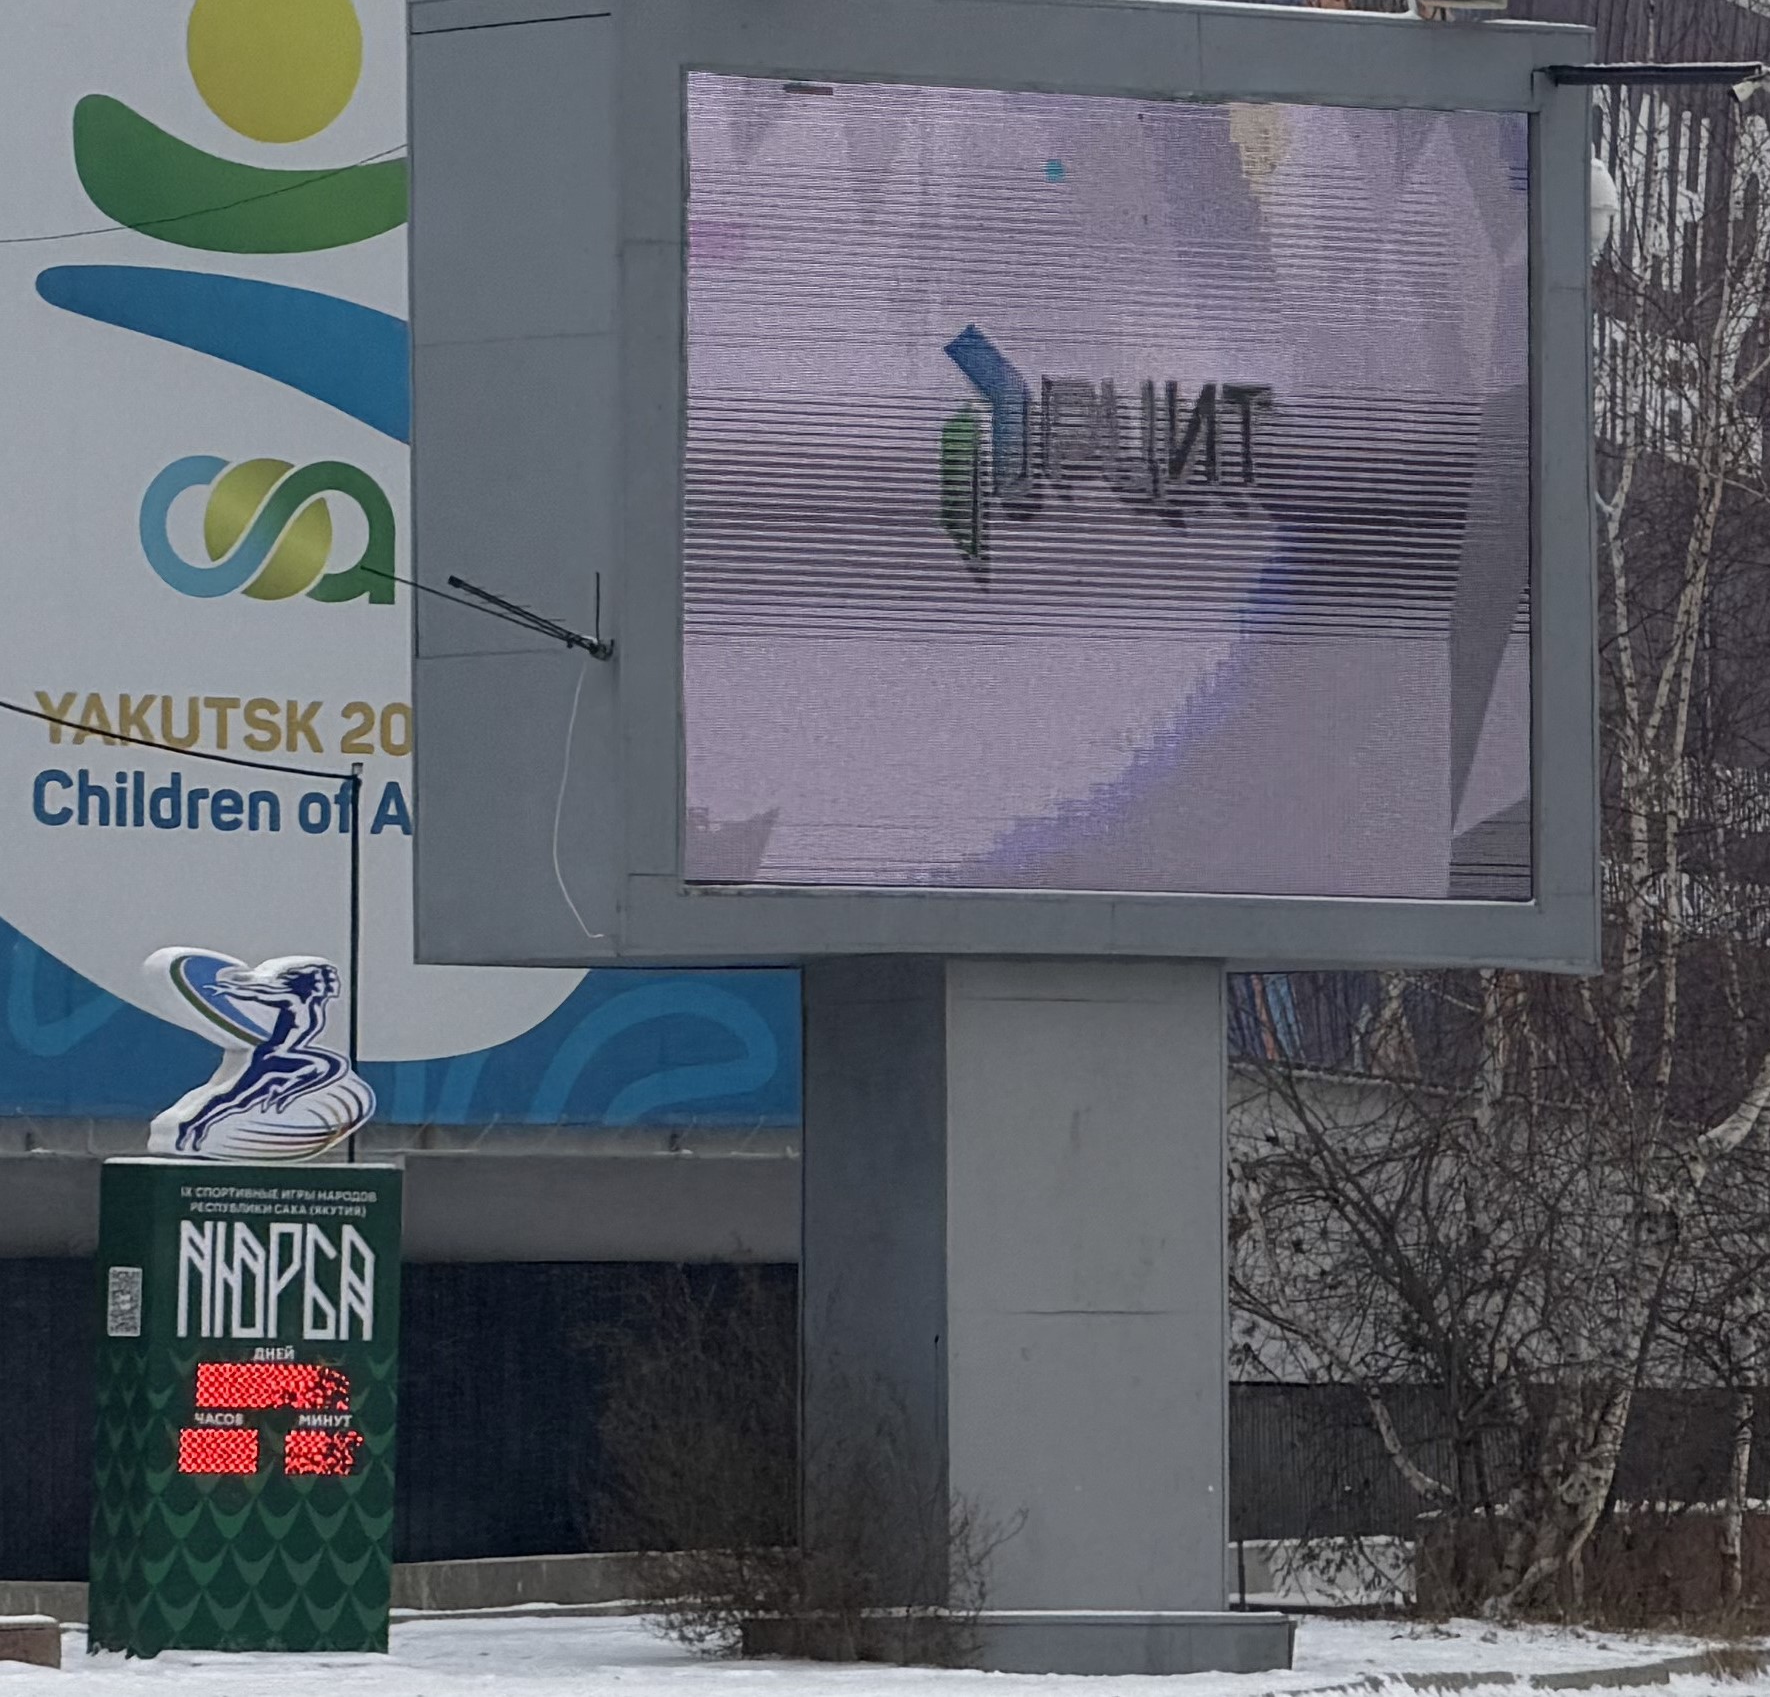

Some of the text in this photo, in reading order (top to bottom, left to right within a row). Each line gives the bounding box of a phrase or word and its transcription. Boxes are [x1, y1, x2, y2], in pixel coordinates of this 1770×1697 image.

[34, 690, 324, 754] YAKUTSK
[33, 768, 281, 833] Children
[299, 778, 358, 834] of
[195, 1187, 278, 1200] СПОРТИВНЫЕ
[281, 1190, 316, 1201] ИГРЫ
[318, 1191, 377, 1202] НАРОДОВ
[190, 1202, 272, 1214] РЕСПУБЛИКИ
[274, 1204, 307, 1215] САХА
[253, 1345, 295, 1361] ДНЕЙ
[195, 1412, 353, 1427] ЧАСОВ МИНУТ
